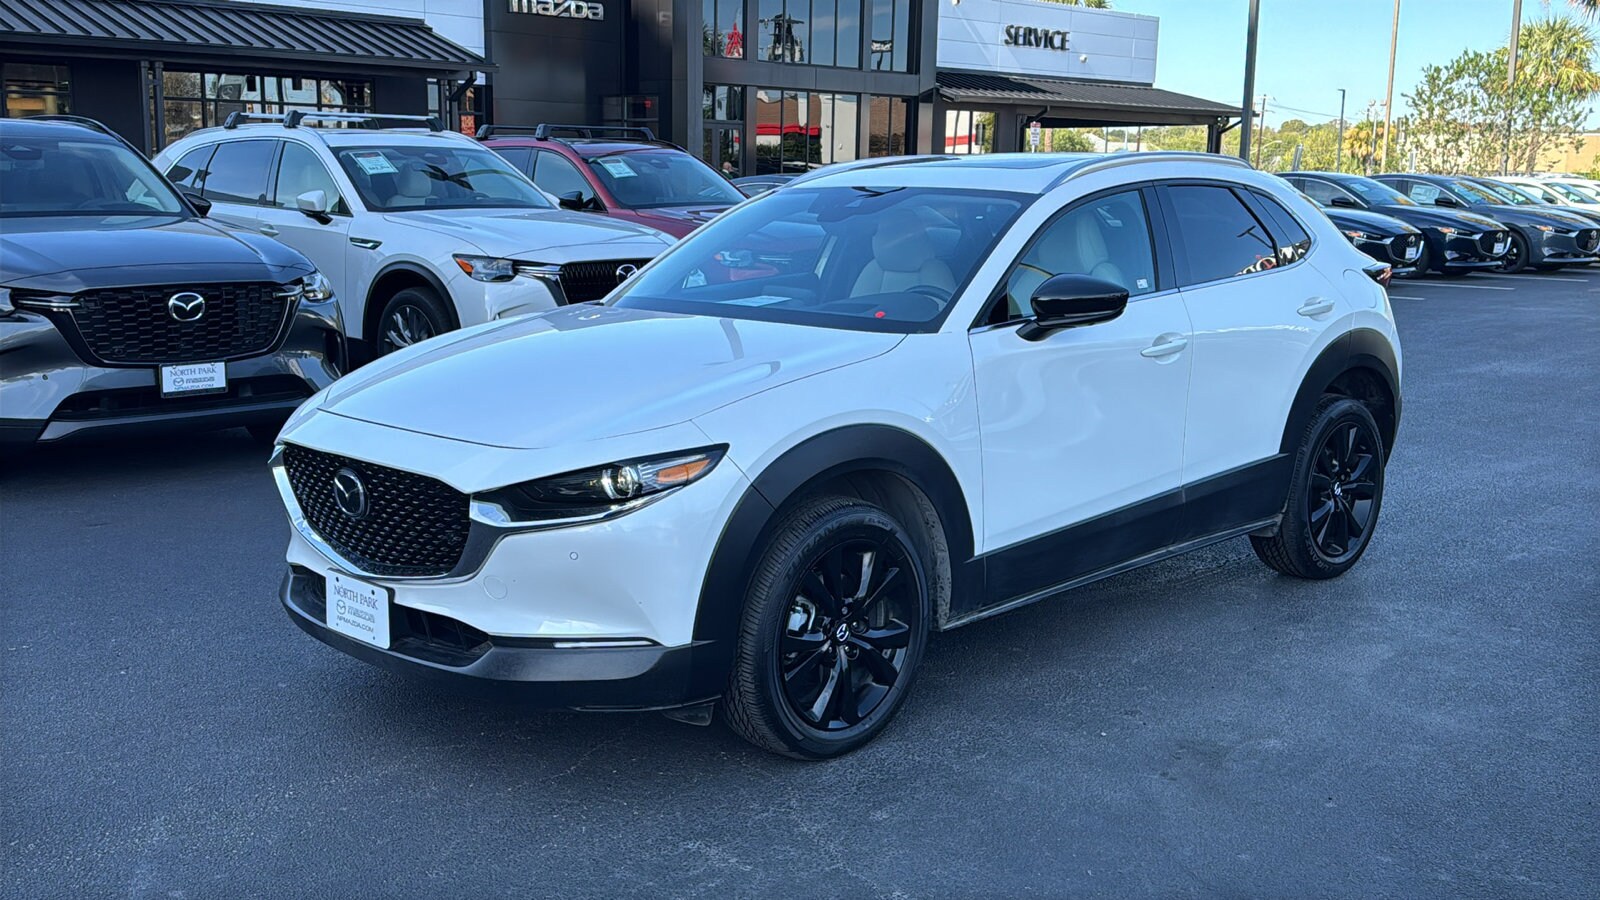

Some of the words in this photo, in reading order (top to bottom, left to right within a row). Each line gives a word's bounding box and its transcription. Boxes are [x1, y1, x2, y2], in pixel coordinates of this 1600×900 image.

[1004, 24, 1070, 51] SERVICE
[169, 368, 197, 377] NORTH
[198, 366, 217, 375] PARK
[333, 583, 359, 603] NORTH
[359, 593, 379, 611] PARK
[336, 614, 374, 633] NPMAZDA.COM
[347, 605, 375, 624] mazda
